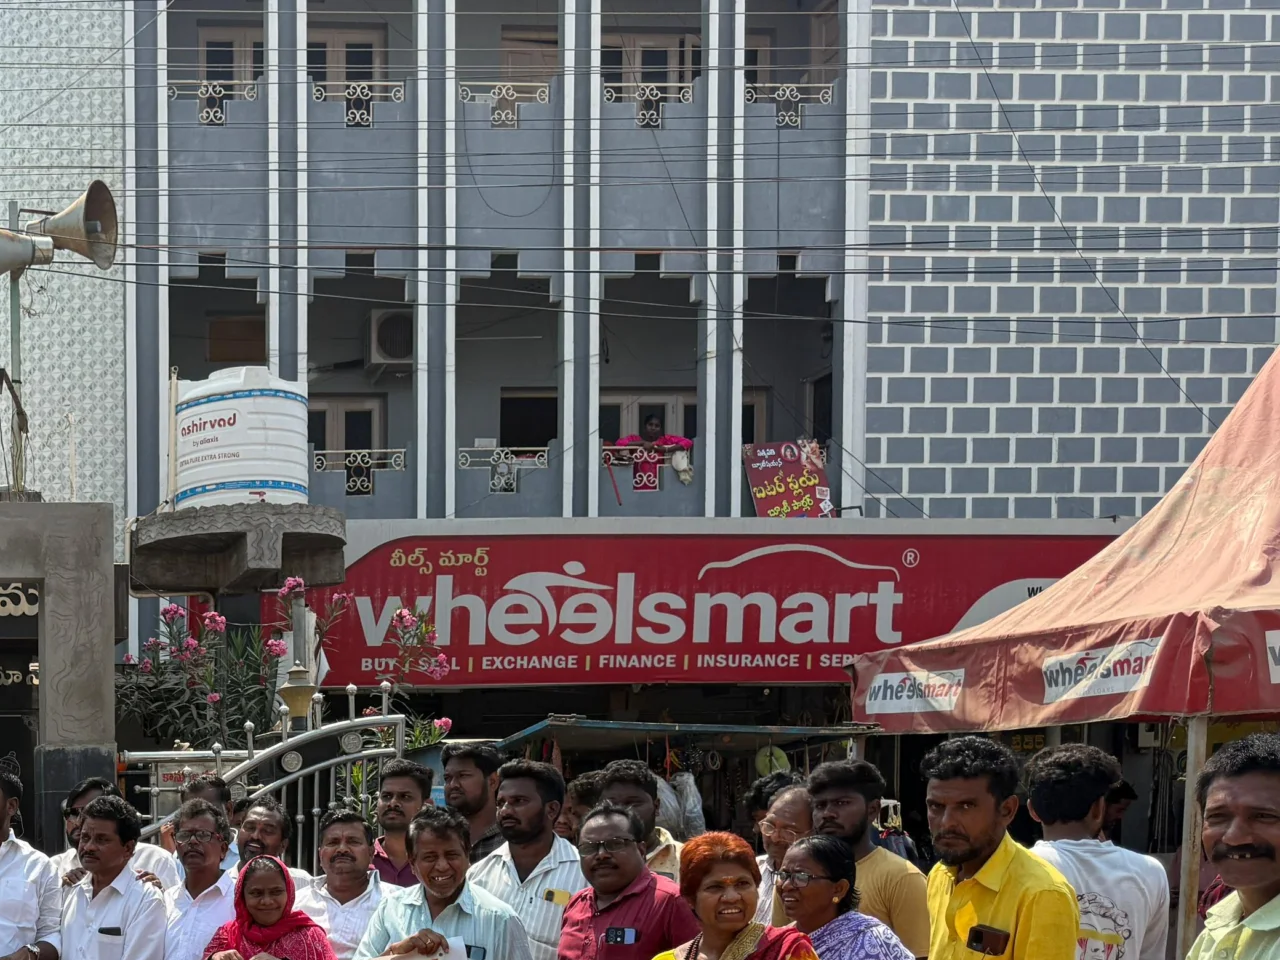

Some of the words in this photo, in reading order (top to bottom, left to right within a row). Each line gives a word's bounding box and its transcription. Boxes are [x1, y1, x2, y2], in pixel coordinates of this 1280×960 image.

[181, 413, 237, 437] ashirvad
[201, 454, 217, 462] EXTRA
[218, 452, 240, 460] STRONG
[389, 547, 433, 575] వీల్స్
[438, 547, 490, 577] మార్ట్
[354, 571, 903, 646] wheelsmart
[361, 657, 396, 671] BUY
[418, 657, 460, 671] SEL
[481, 655, 578, 670] EXCHANGE
[599, 654, 676, 669] FINANCE
[696, 654, 799, 669] INSURANCE
[868, 677, 962, 701] wheelsmart
